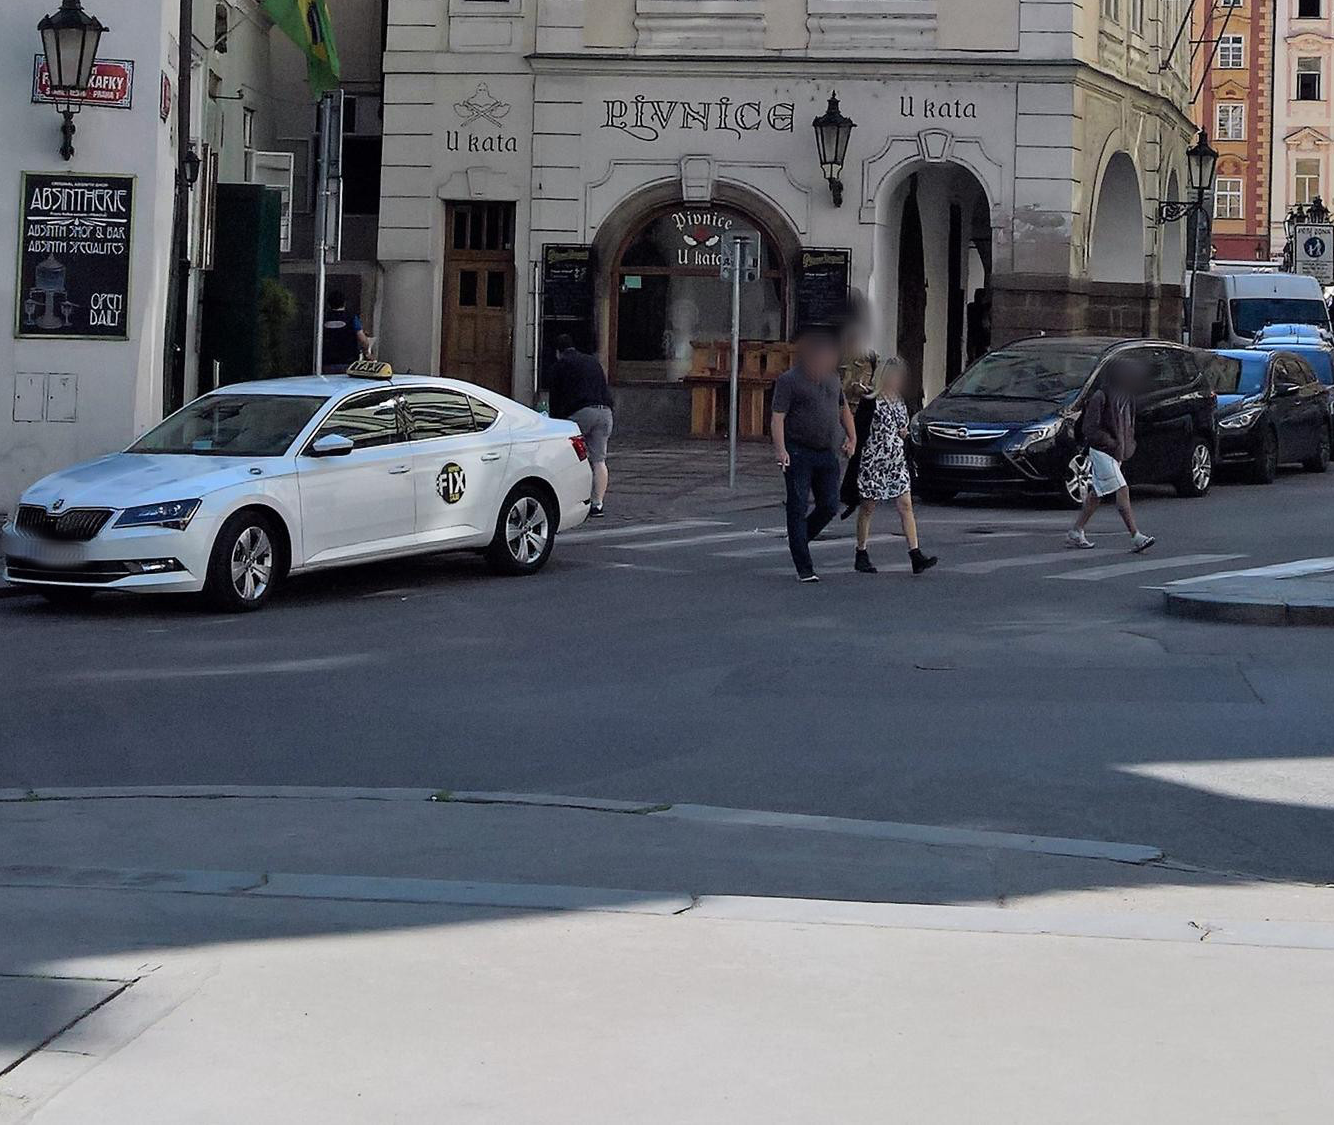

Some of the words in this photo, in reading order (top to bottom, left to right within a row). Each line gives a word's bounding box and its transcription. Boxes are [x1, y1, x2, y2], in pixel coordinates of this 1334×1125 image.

[87, 76, 125, 90] KAFKY
[900, 96, 914, 117] U
[924, 99, 976, 119] kata
[446, 130, 459, 152] U
[468, 133, 517, 153] kata
[30, 188, 127, 212] ABSINTHERIE
[672, 212, 732, 231] Pivnice
[28, 225, 67, 237] ABSINTH
[96, 227, 104, 238] &
[107, 227, 125, 239] BAR
[28, 240, 67, 253] ABSINTH
[678, 249, 688, 265] U
[91, 293, 122, 310] OPEN
[353, 361, 384, 372] TAXI
[438, 471, 465, 496] FIX
